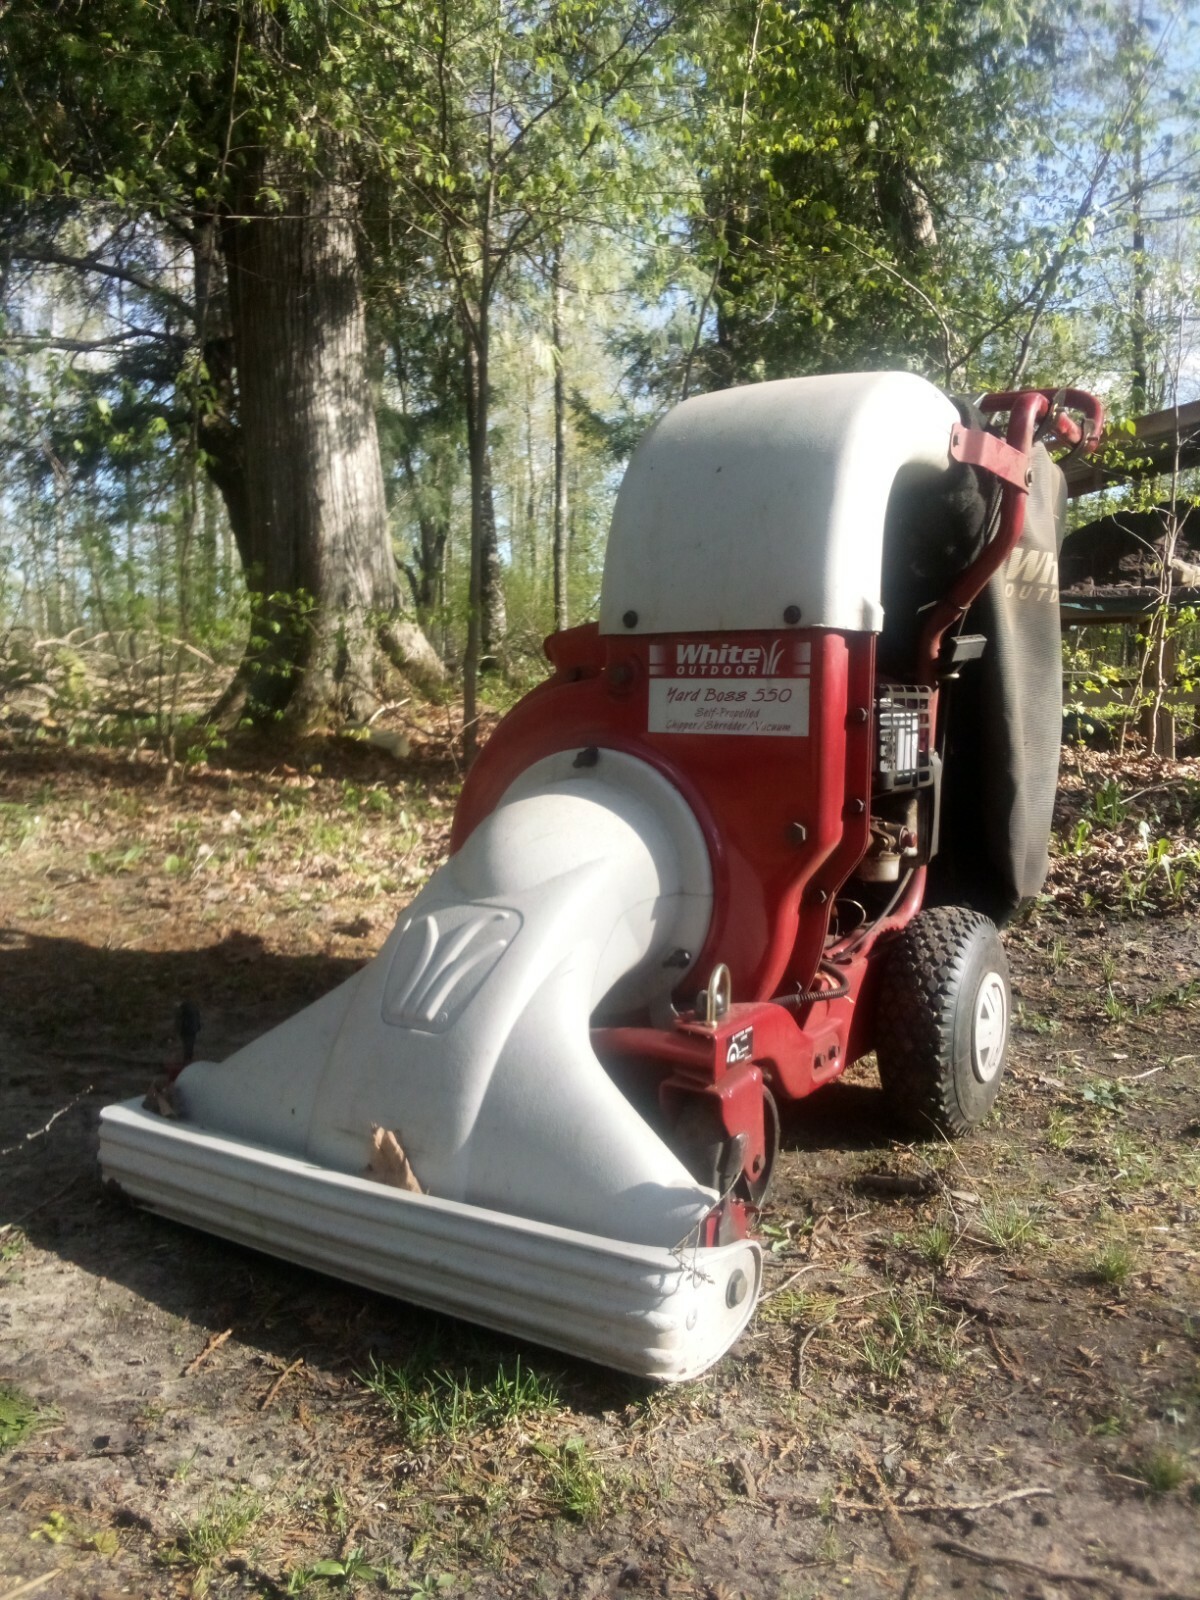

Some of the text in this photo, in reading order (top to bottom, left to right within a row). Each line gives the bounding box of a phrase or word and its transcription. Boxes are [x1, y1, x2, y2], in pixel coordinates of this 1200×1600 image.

[676, 643, 761, 665] White
[676, 664, 756, 676] OUTDOOR
[667, 687, 793, 704] Yard Boss 550
[694, 707, 761, 720] Self-Propelled
